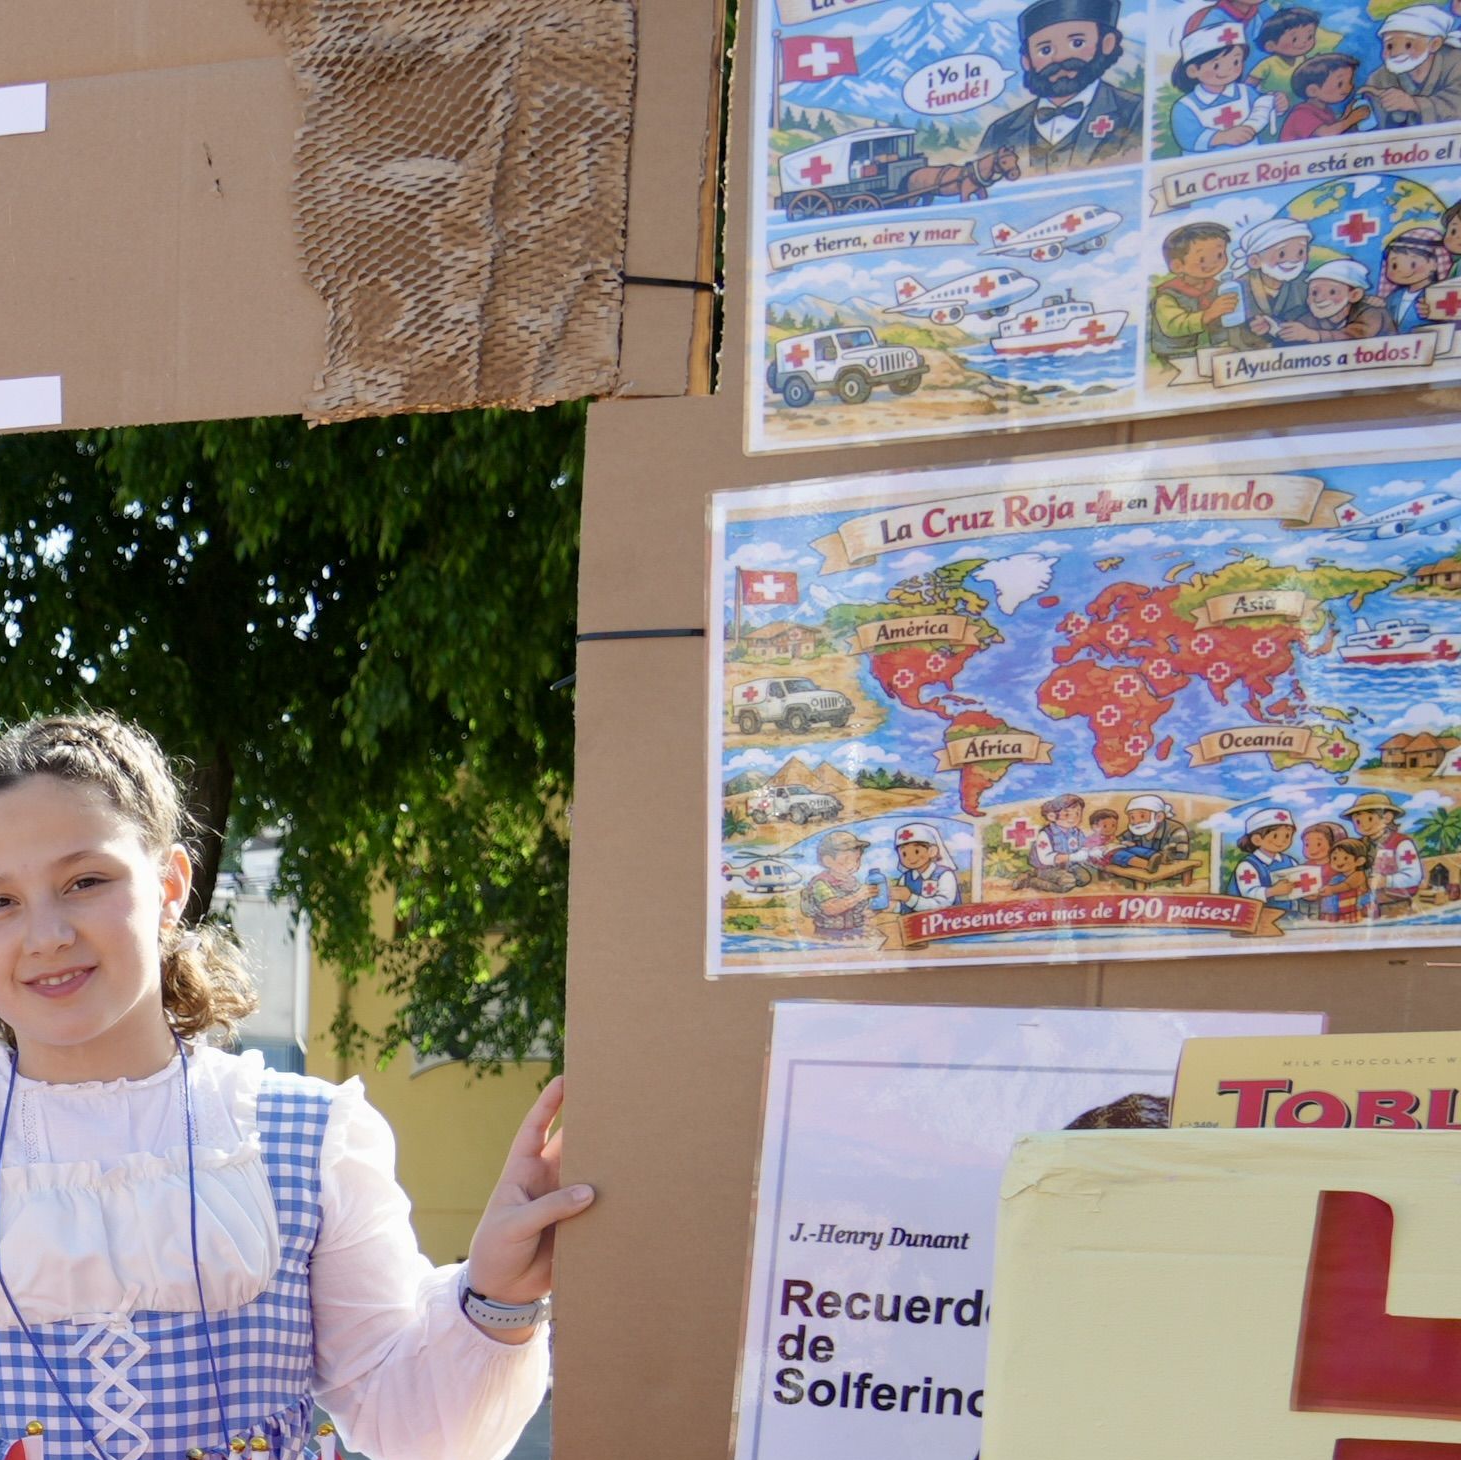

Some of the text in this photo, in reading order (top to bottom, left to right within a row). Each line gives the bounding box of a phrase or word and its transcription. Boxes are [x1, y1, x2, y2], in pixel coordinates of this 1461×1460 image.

[964, 63, 981, 79] la
[1174, 141, 1453, 197] La Cruz Roja está en todo el
[779, 228, 961, 260] Por tierra, aire y mar
[1226, 340, 1422, 379] ¡Ayudamos a todos!
[881, 480, 1274, 545] La Cruz Roja en Mundo
[1233, 596, 1277, 614] Asia
[875, 618, 949, 644] América
[964, 731, 1022, 758] África
[921, 897, 1241, 936] ¡Presentes en más de 190 países!
[1332, 1058, 1437, 1066] CHOCOLATE
[790, 1222, 970, 1252] J.-Henry Dunant
[779, 1280, 990, 1327] Recuerd
[778, 1325, 834, 1363] de
